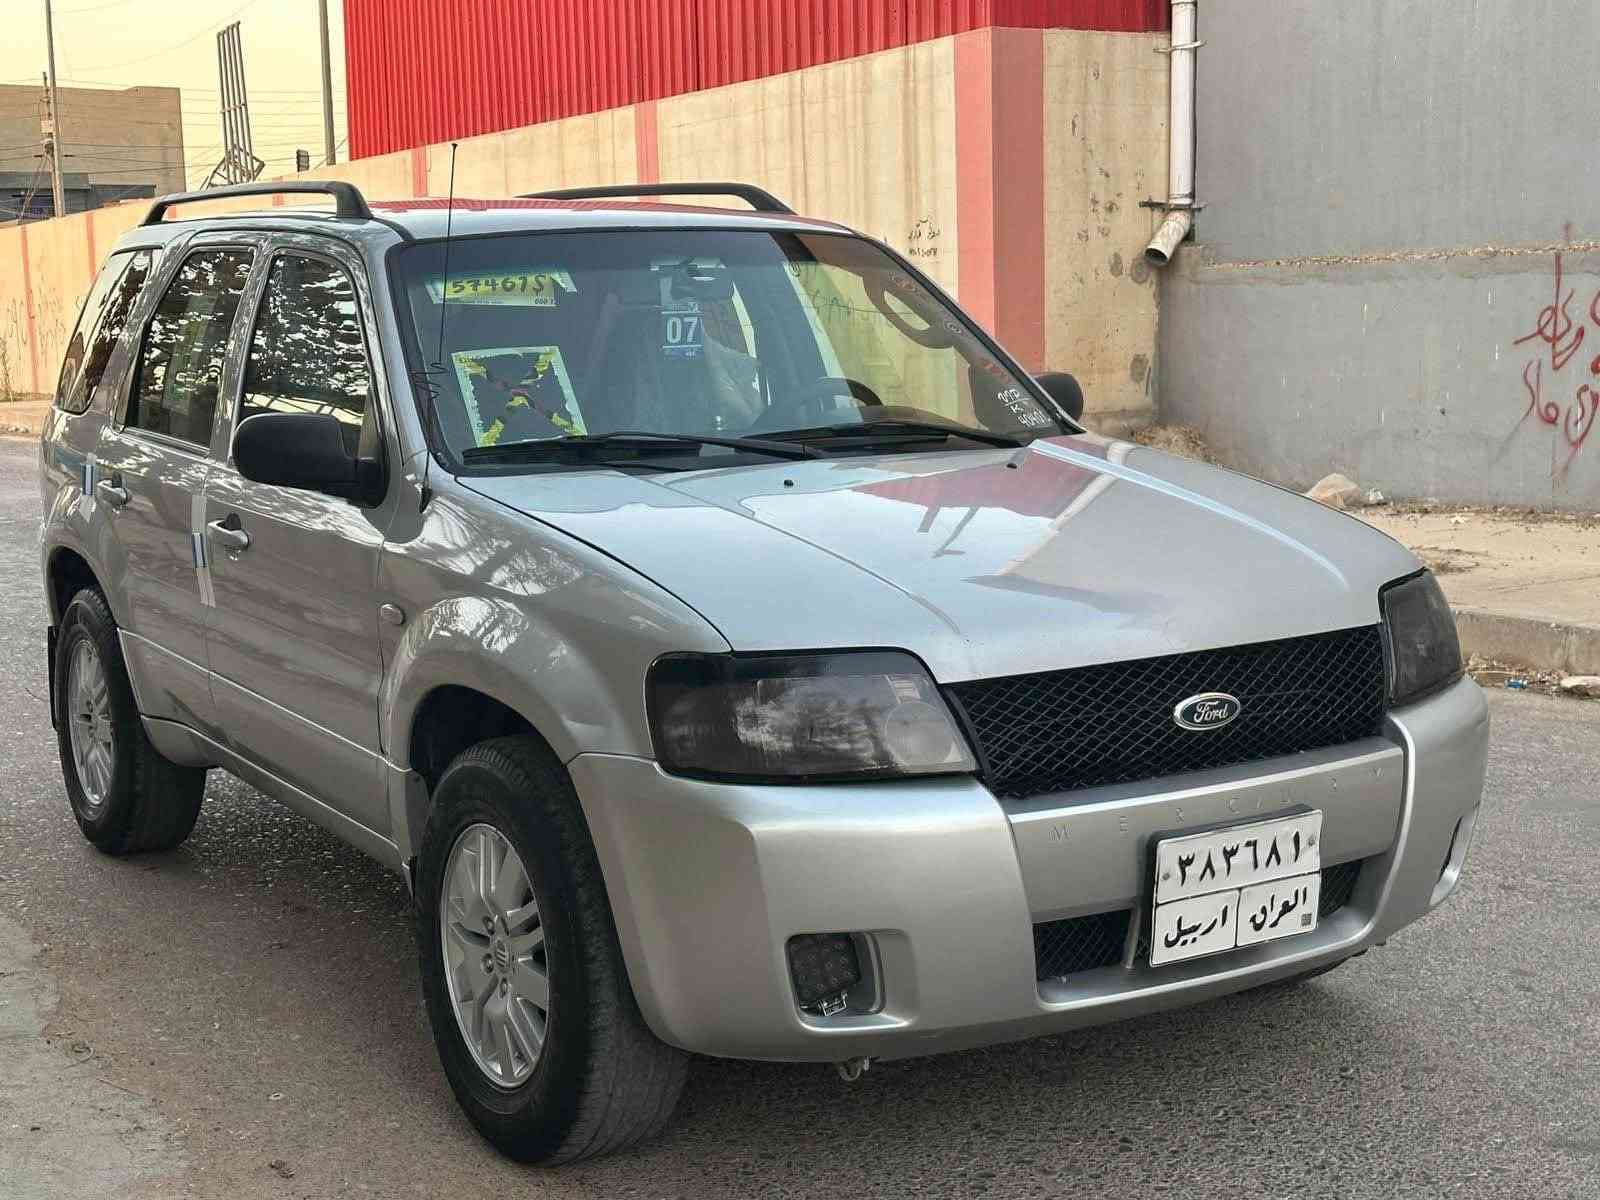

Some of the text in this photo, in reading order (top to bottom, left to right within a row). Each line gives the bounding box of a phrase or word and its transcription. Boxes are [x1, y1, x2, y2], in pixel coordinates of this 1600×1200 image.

[666, 316, 698, 343] 07
[1194, 701, 1229, 723] Ford
[1178, 831, 1301, 887] ٣٨٣٦٨١
[1249, 886, 1308, 932] العراق
